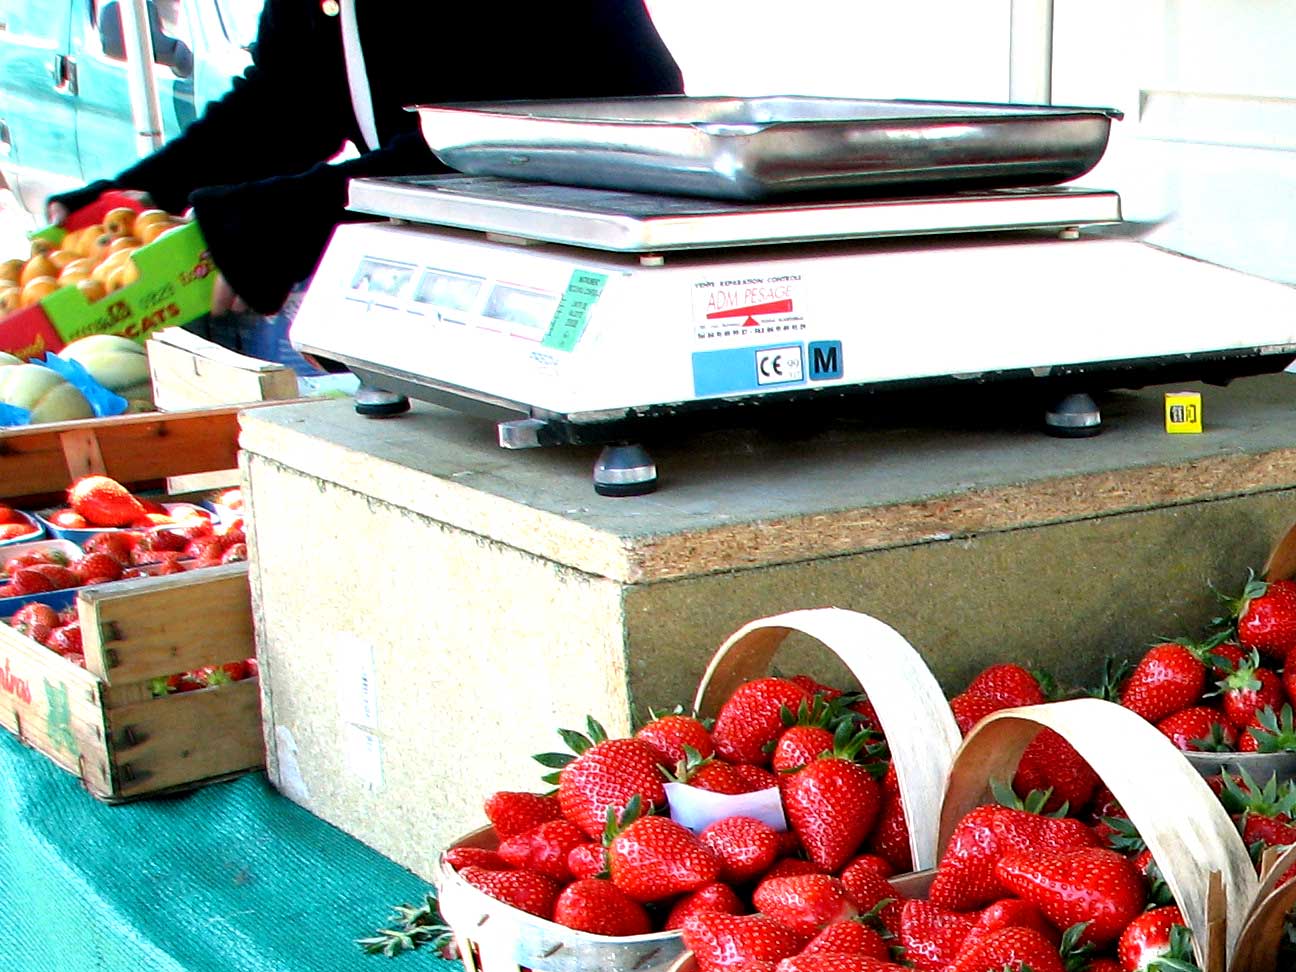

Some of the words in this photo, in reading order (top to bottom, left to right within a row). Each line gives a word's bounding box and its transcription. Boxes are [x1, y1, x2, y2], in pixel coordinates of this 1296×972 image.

[707, 290, 738, 311] ADM
[745, 285, 792, 304] PESAGE
[760, 355, 782, 377] CE
[814, 347, 837, 374] M
